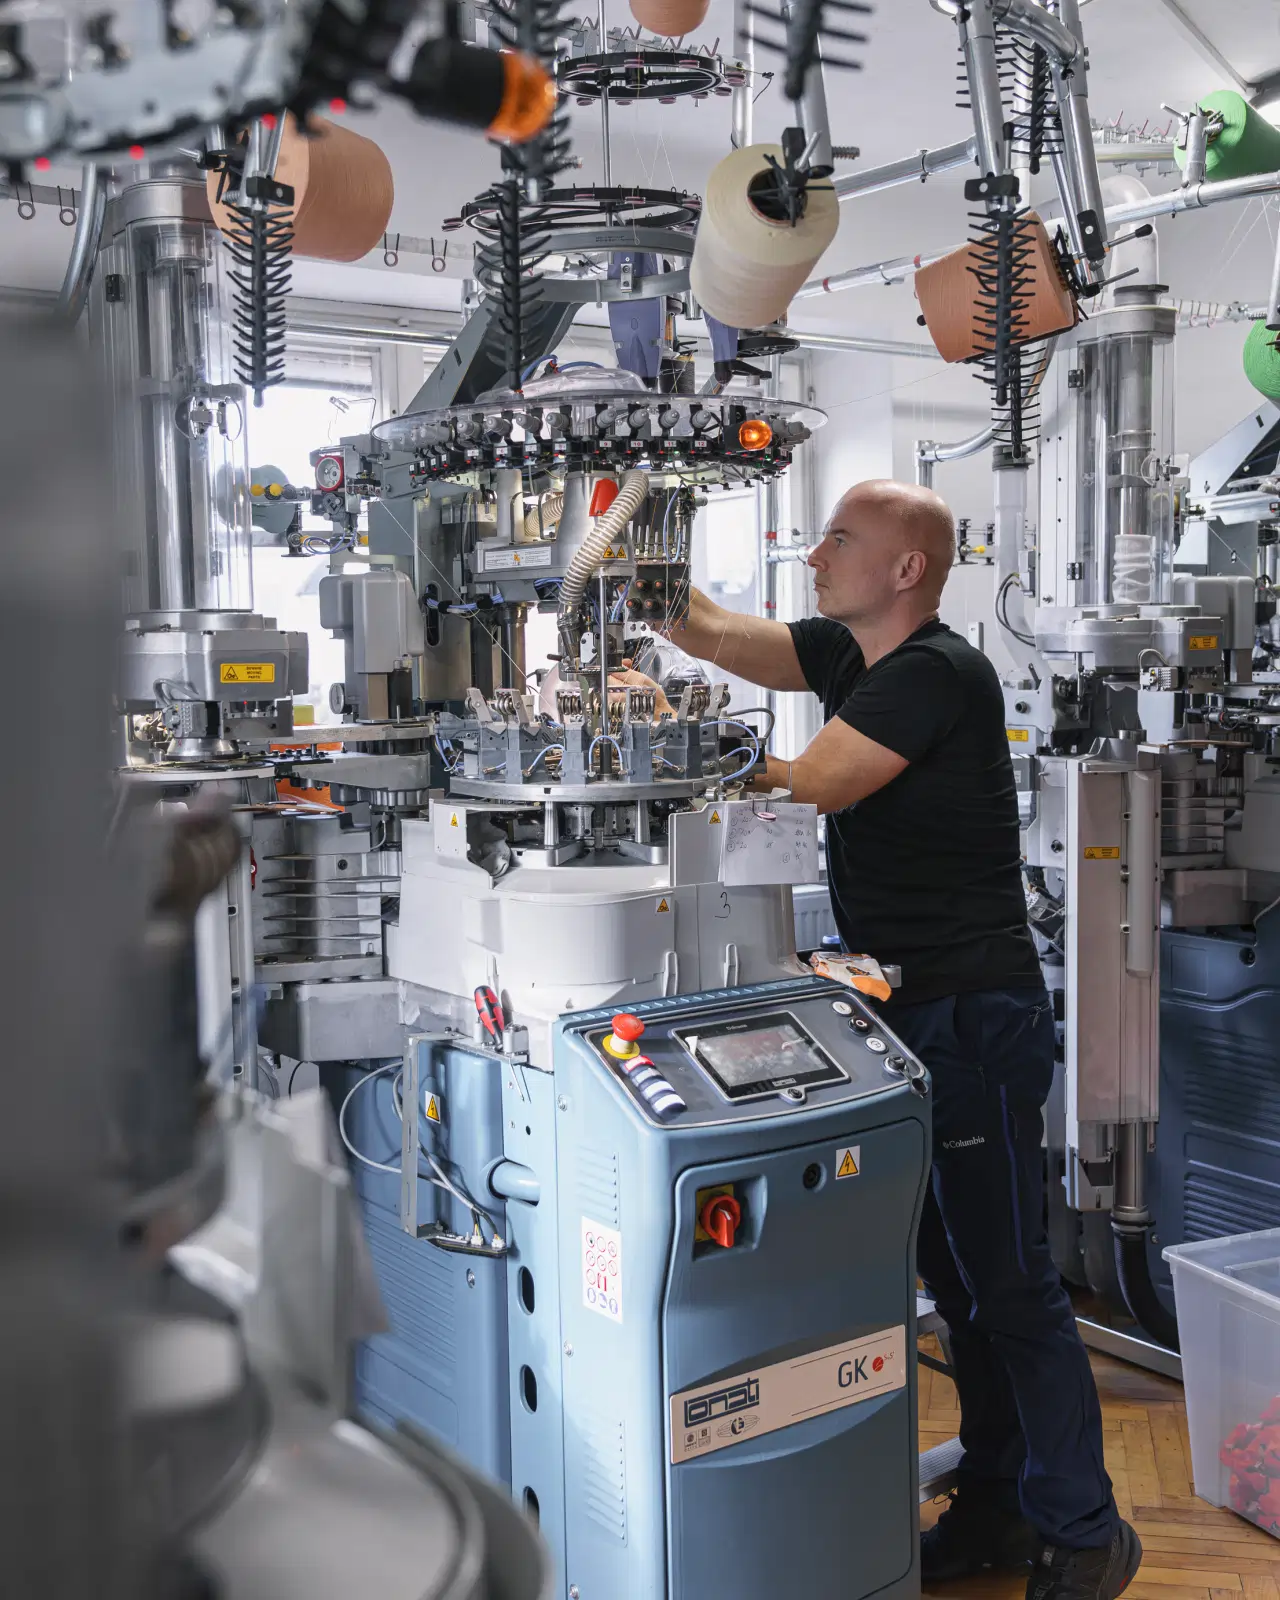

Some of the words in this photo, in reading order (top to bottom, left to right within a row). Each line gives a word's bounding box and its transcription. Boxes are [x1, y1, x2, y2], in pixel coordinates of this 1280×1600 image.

[715, 892, 731, 919] 3
[949, 1135, 985, 1149] Columbia
[838, 1355, 869, 1388] GK
